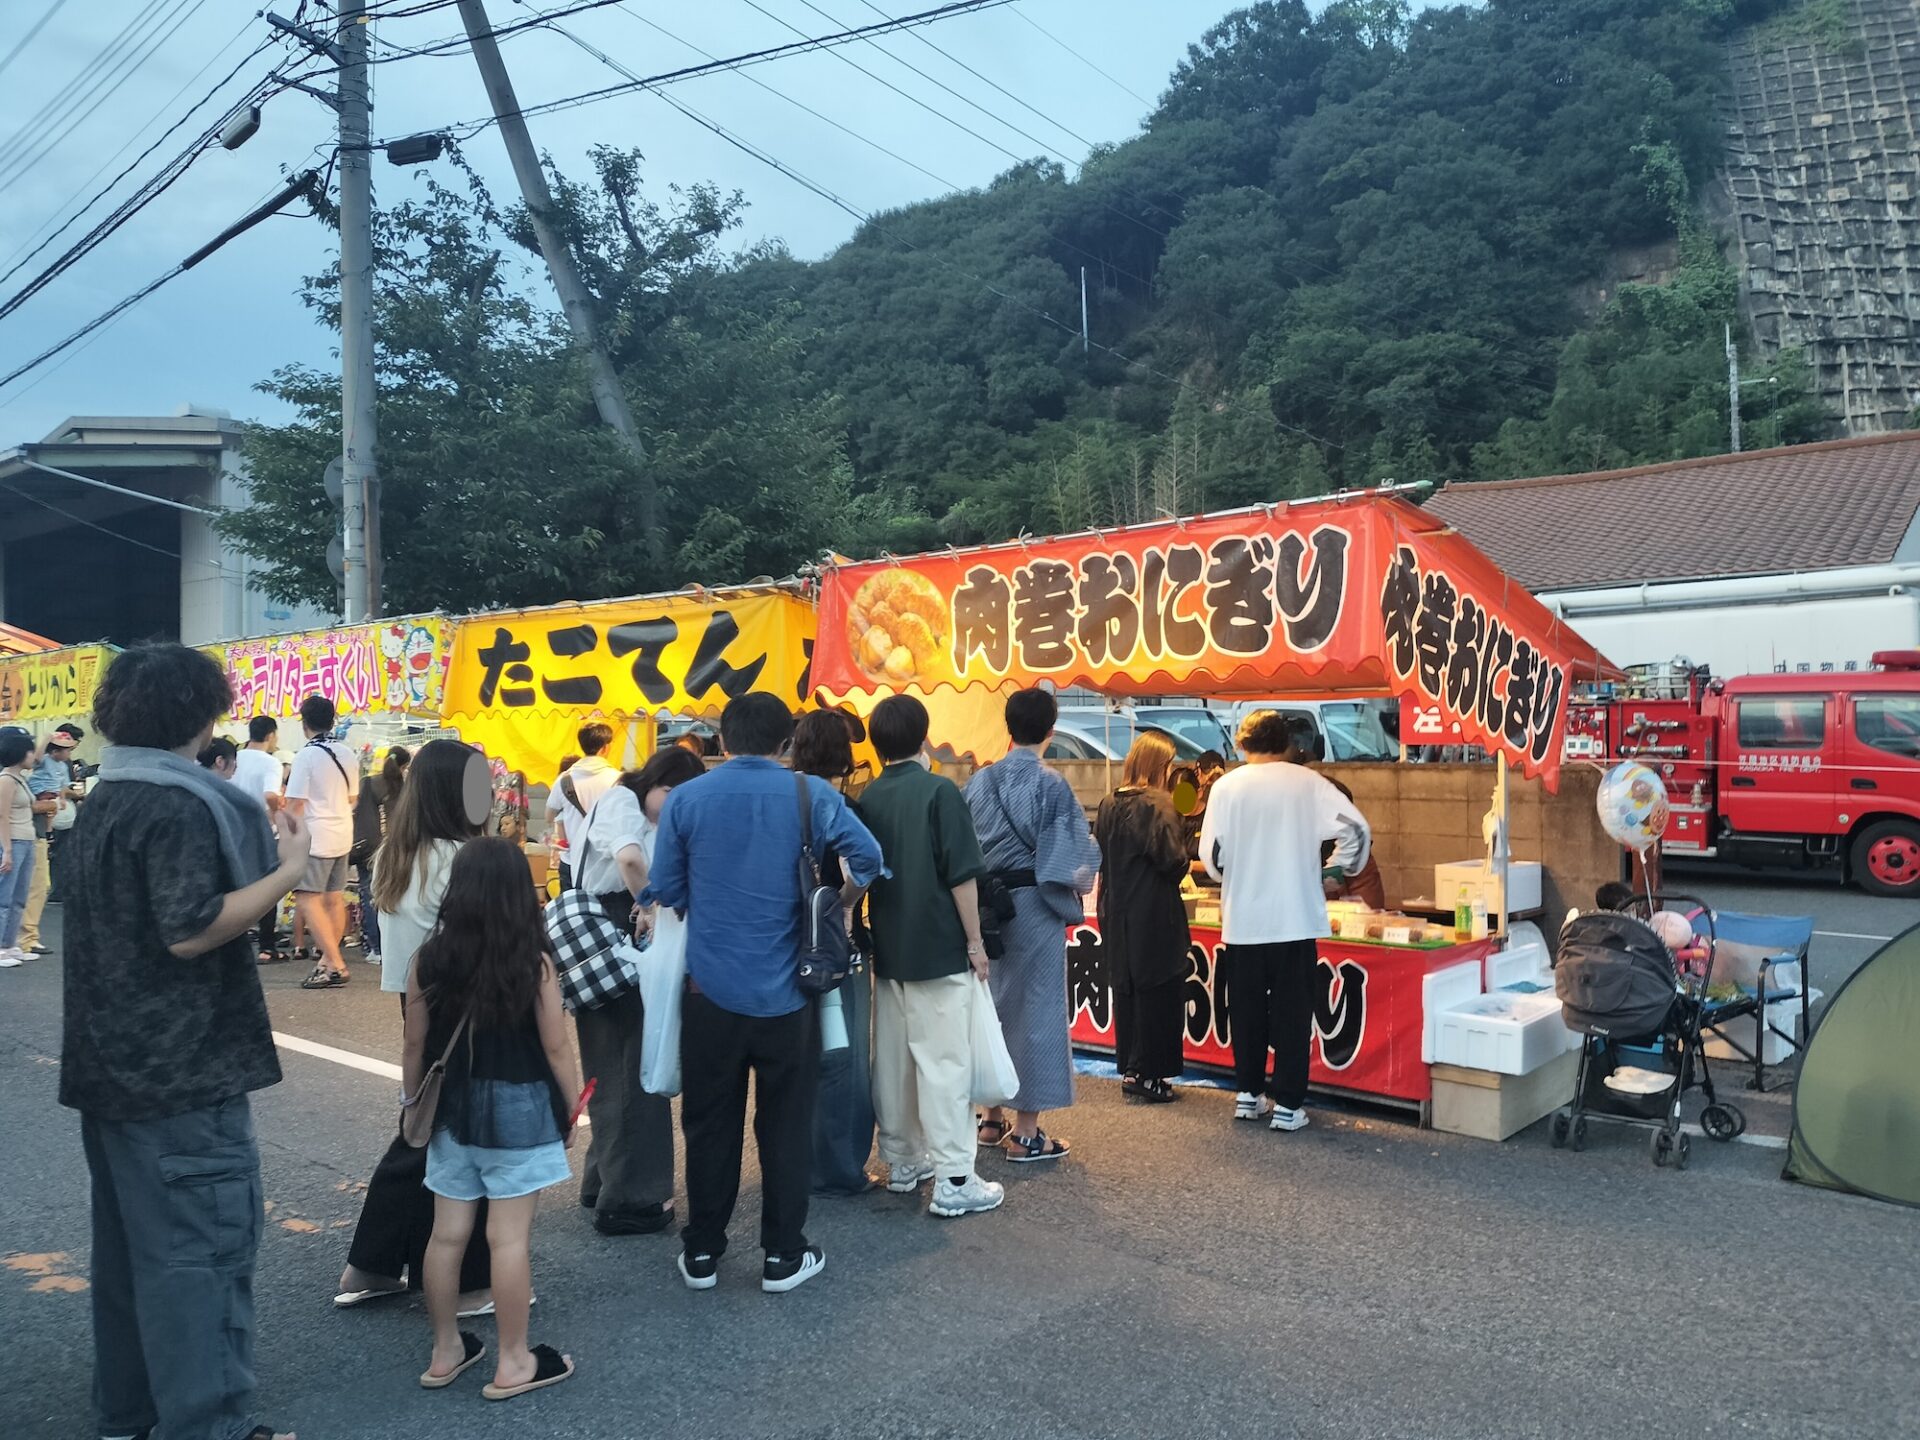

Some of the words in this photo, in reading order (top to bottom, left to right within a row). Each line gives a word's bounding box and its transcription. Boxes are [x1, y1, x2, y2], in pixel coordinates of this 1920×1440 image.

[477, 610, 767, 707] たこてん
[952, 525, 1350, 675] 肉巻おにぎり
[1382, 545, 1563, 762] 肉巻おにぎり
